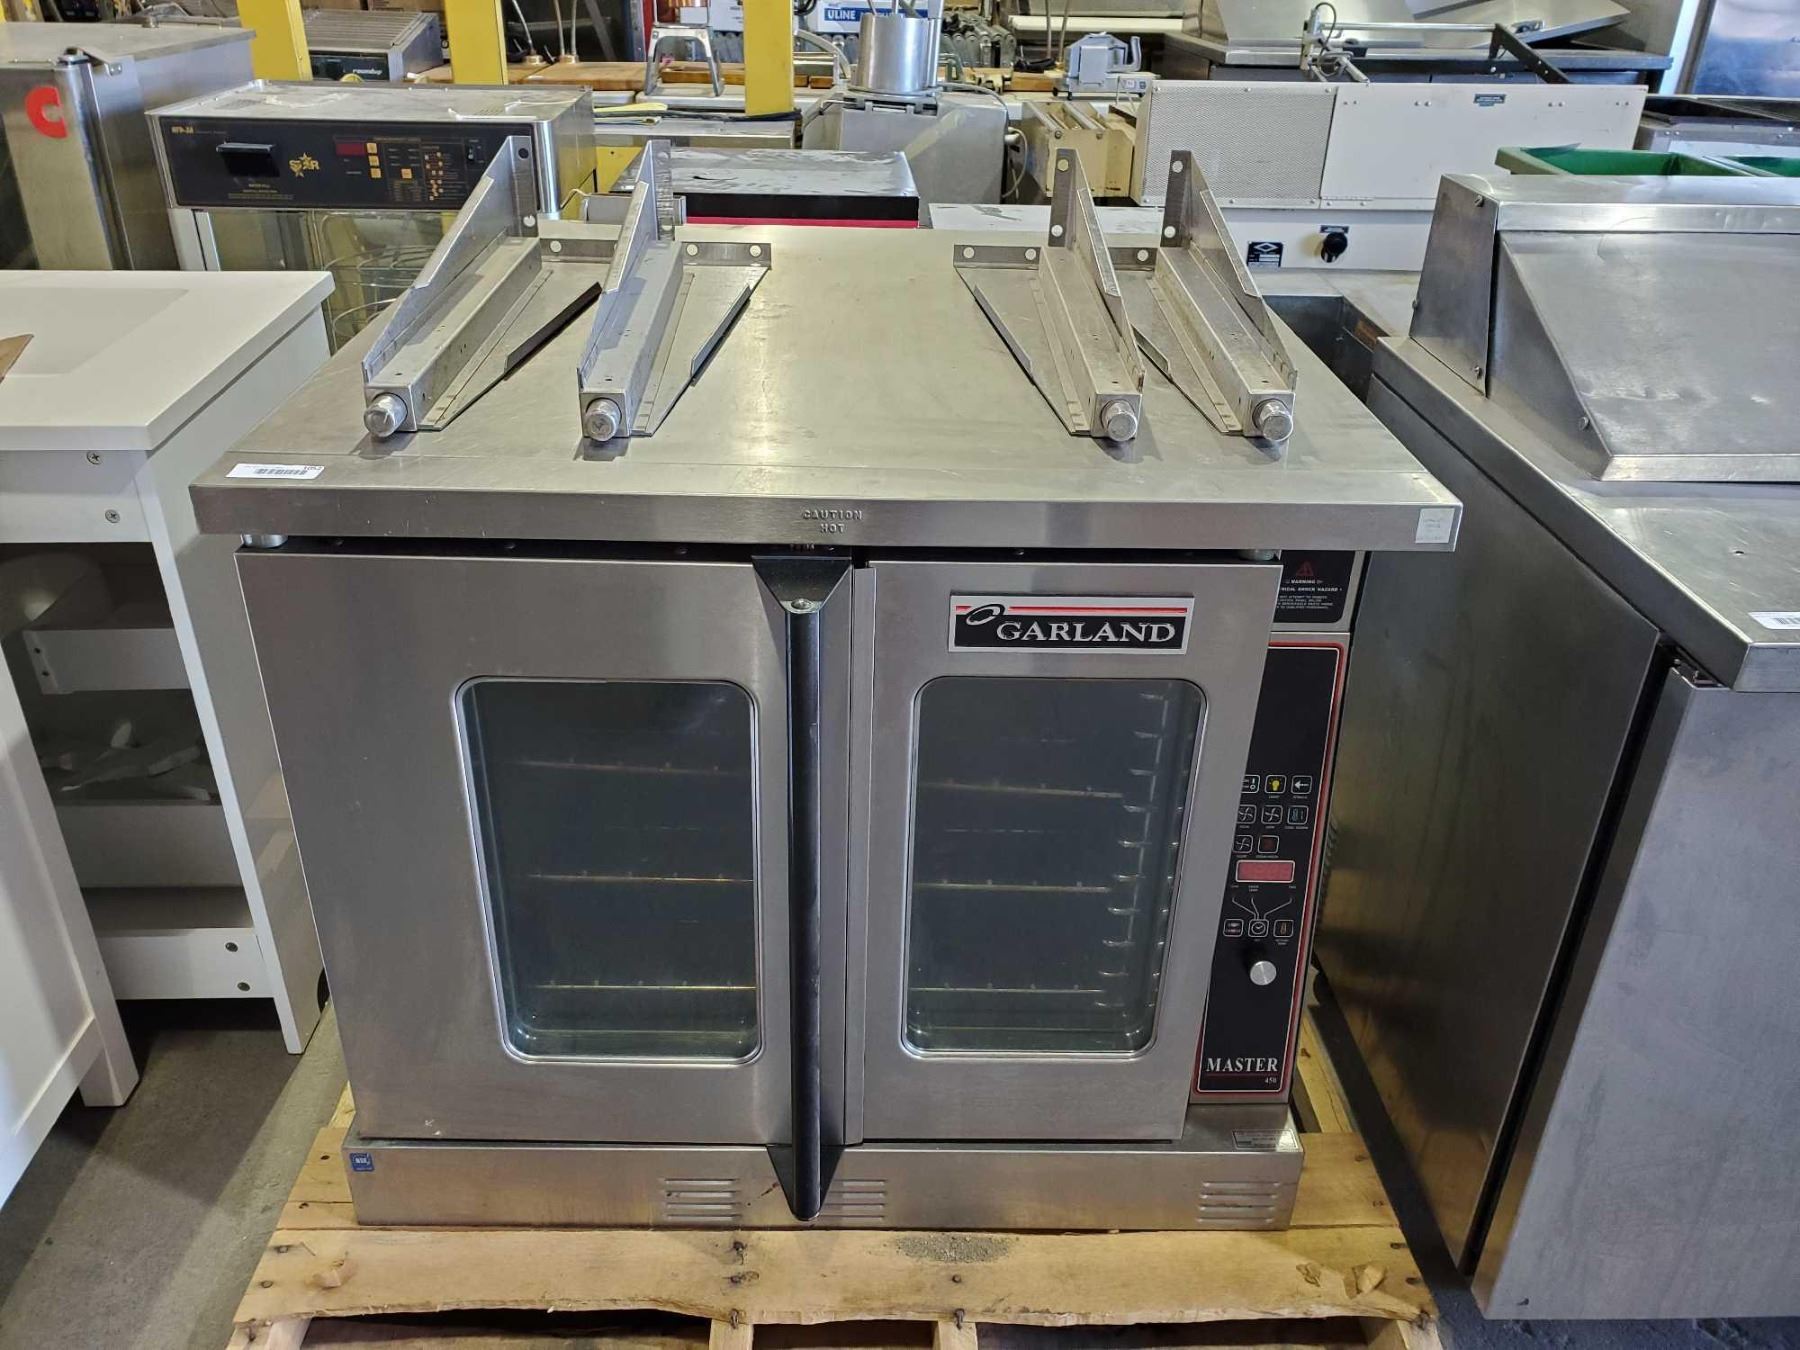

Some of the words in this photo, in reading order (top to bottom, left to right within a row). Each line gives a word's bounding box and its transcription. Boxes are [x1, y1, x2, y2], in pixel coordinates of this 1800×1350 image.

[827, 10, 856, 20] ULINE
[803, 509, 863, 520] CAUTION
[820, 523, 845, 533] HOT
[996, 621, 1176, 642] GARLAND
[1206, 1057, 1278, 1072] MASTER
